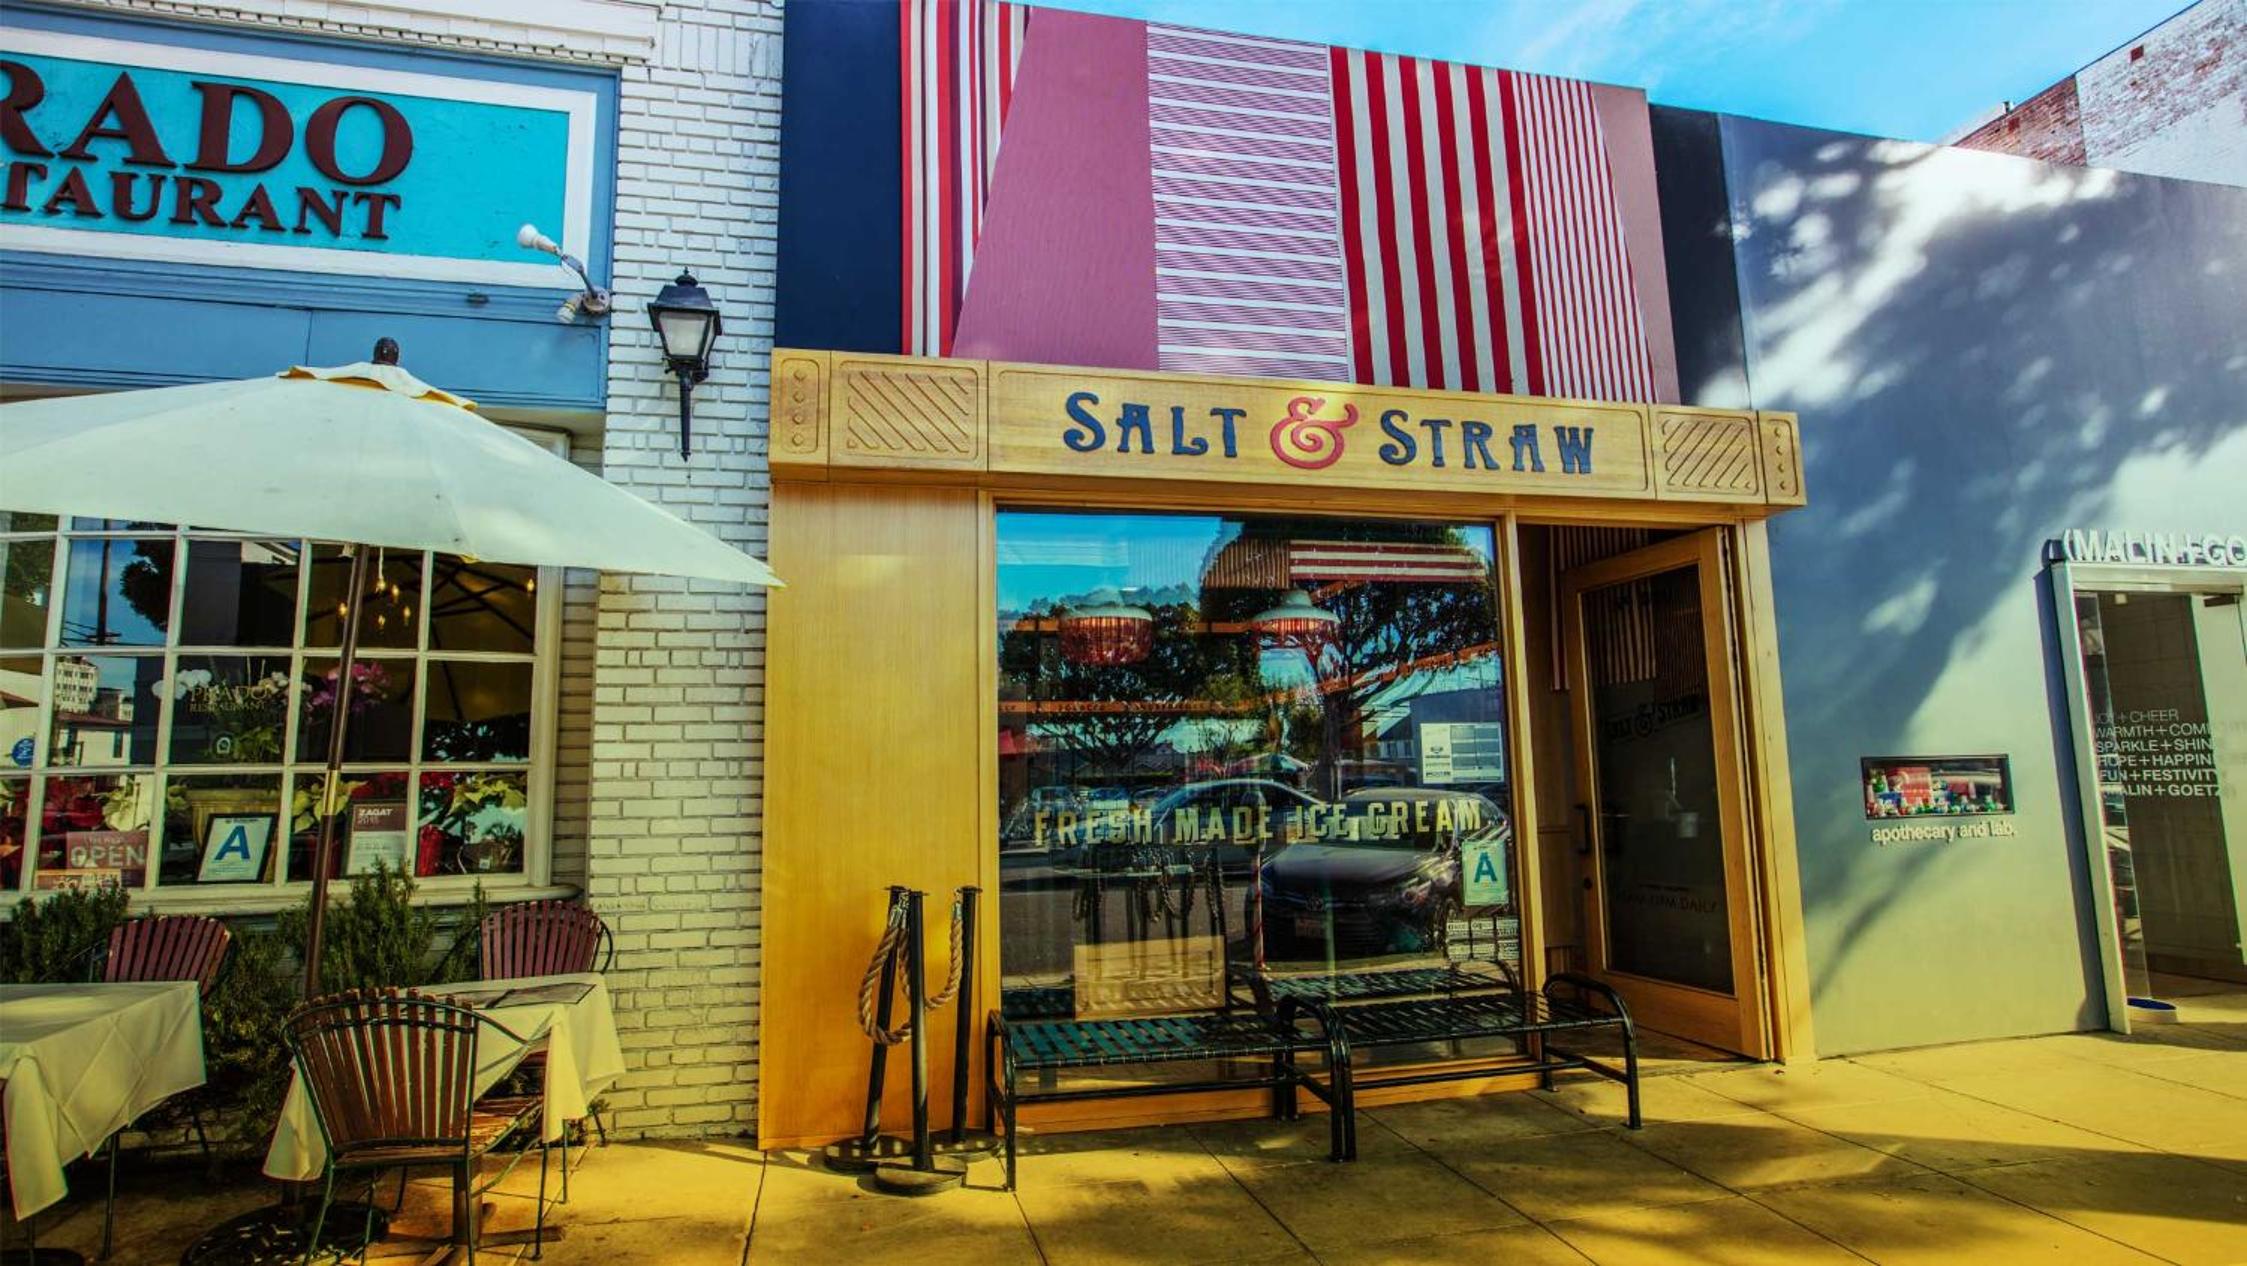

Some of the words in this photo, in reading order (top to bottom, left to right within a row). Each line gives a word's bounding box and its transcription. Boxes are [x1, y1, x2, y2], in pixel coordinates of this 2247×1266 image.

[1, 161, 401, 241] TAURANT
[1063, 391, 1247, 458] SALT
[1269, 397, 1358, 469] &
[1378, 409, 1594, 474] STRAW
[1034, 807, 1153, 847] FRESH
[1173, 805, 1273, 845] MADE
[1295, 802, 1349, 839] ICE
[1366, 798, 1482, 840] CREAM
[1872, 825, 1956, 845] apothecary
[1959, 822, 1988, 838] and
[70, 846, 146, 869] OPEN
[213, 825, 251, 861] A
[1473, 852, 1498, 883] A
